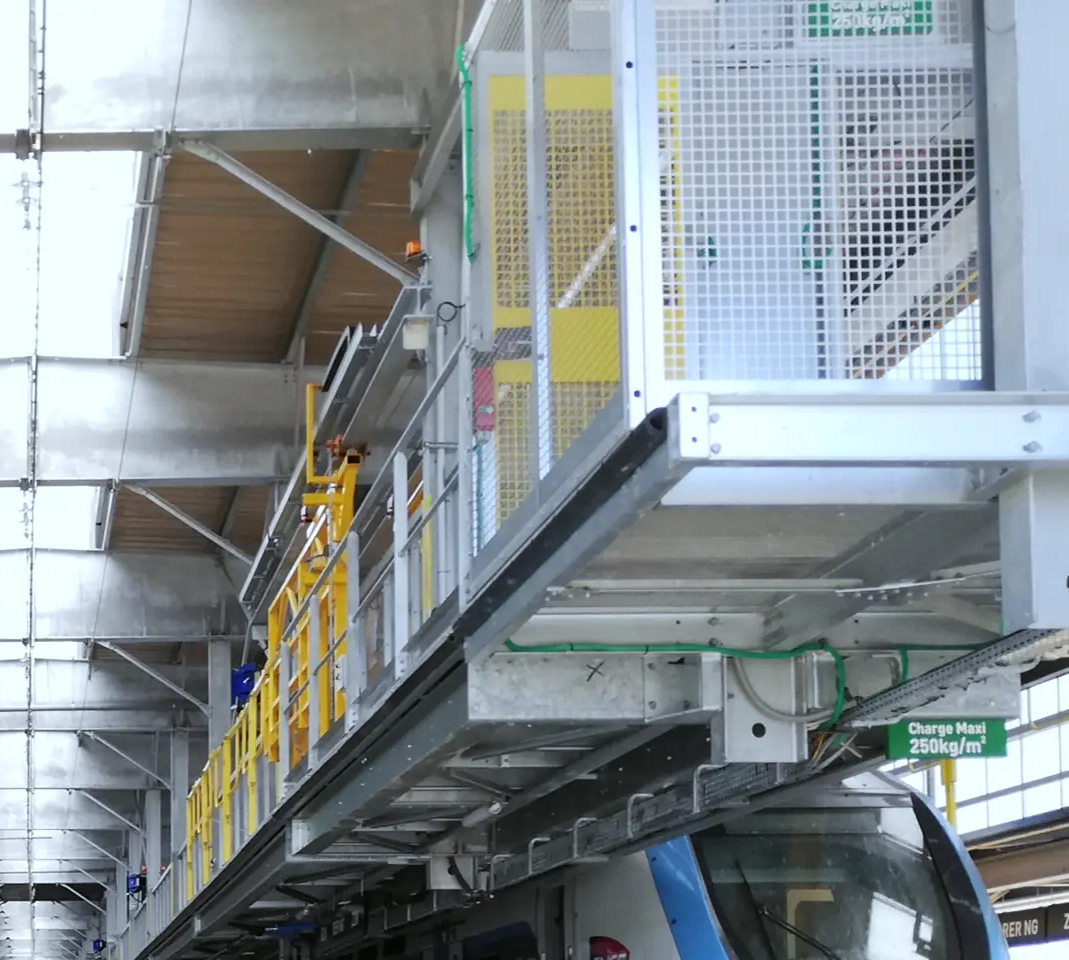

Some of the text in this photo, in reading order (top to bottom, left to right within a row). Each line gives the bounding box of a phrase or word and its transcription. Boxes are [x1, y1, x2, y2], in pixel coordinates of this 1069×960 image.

[908, 721, 986, 737] Charge Maxi
[1024, 918, 1039, 936] NG
